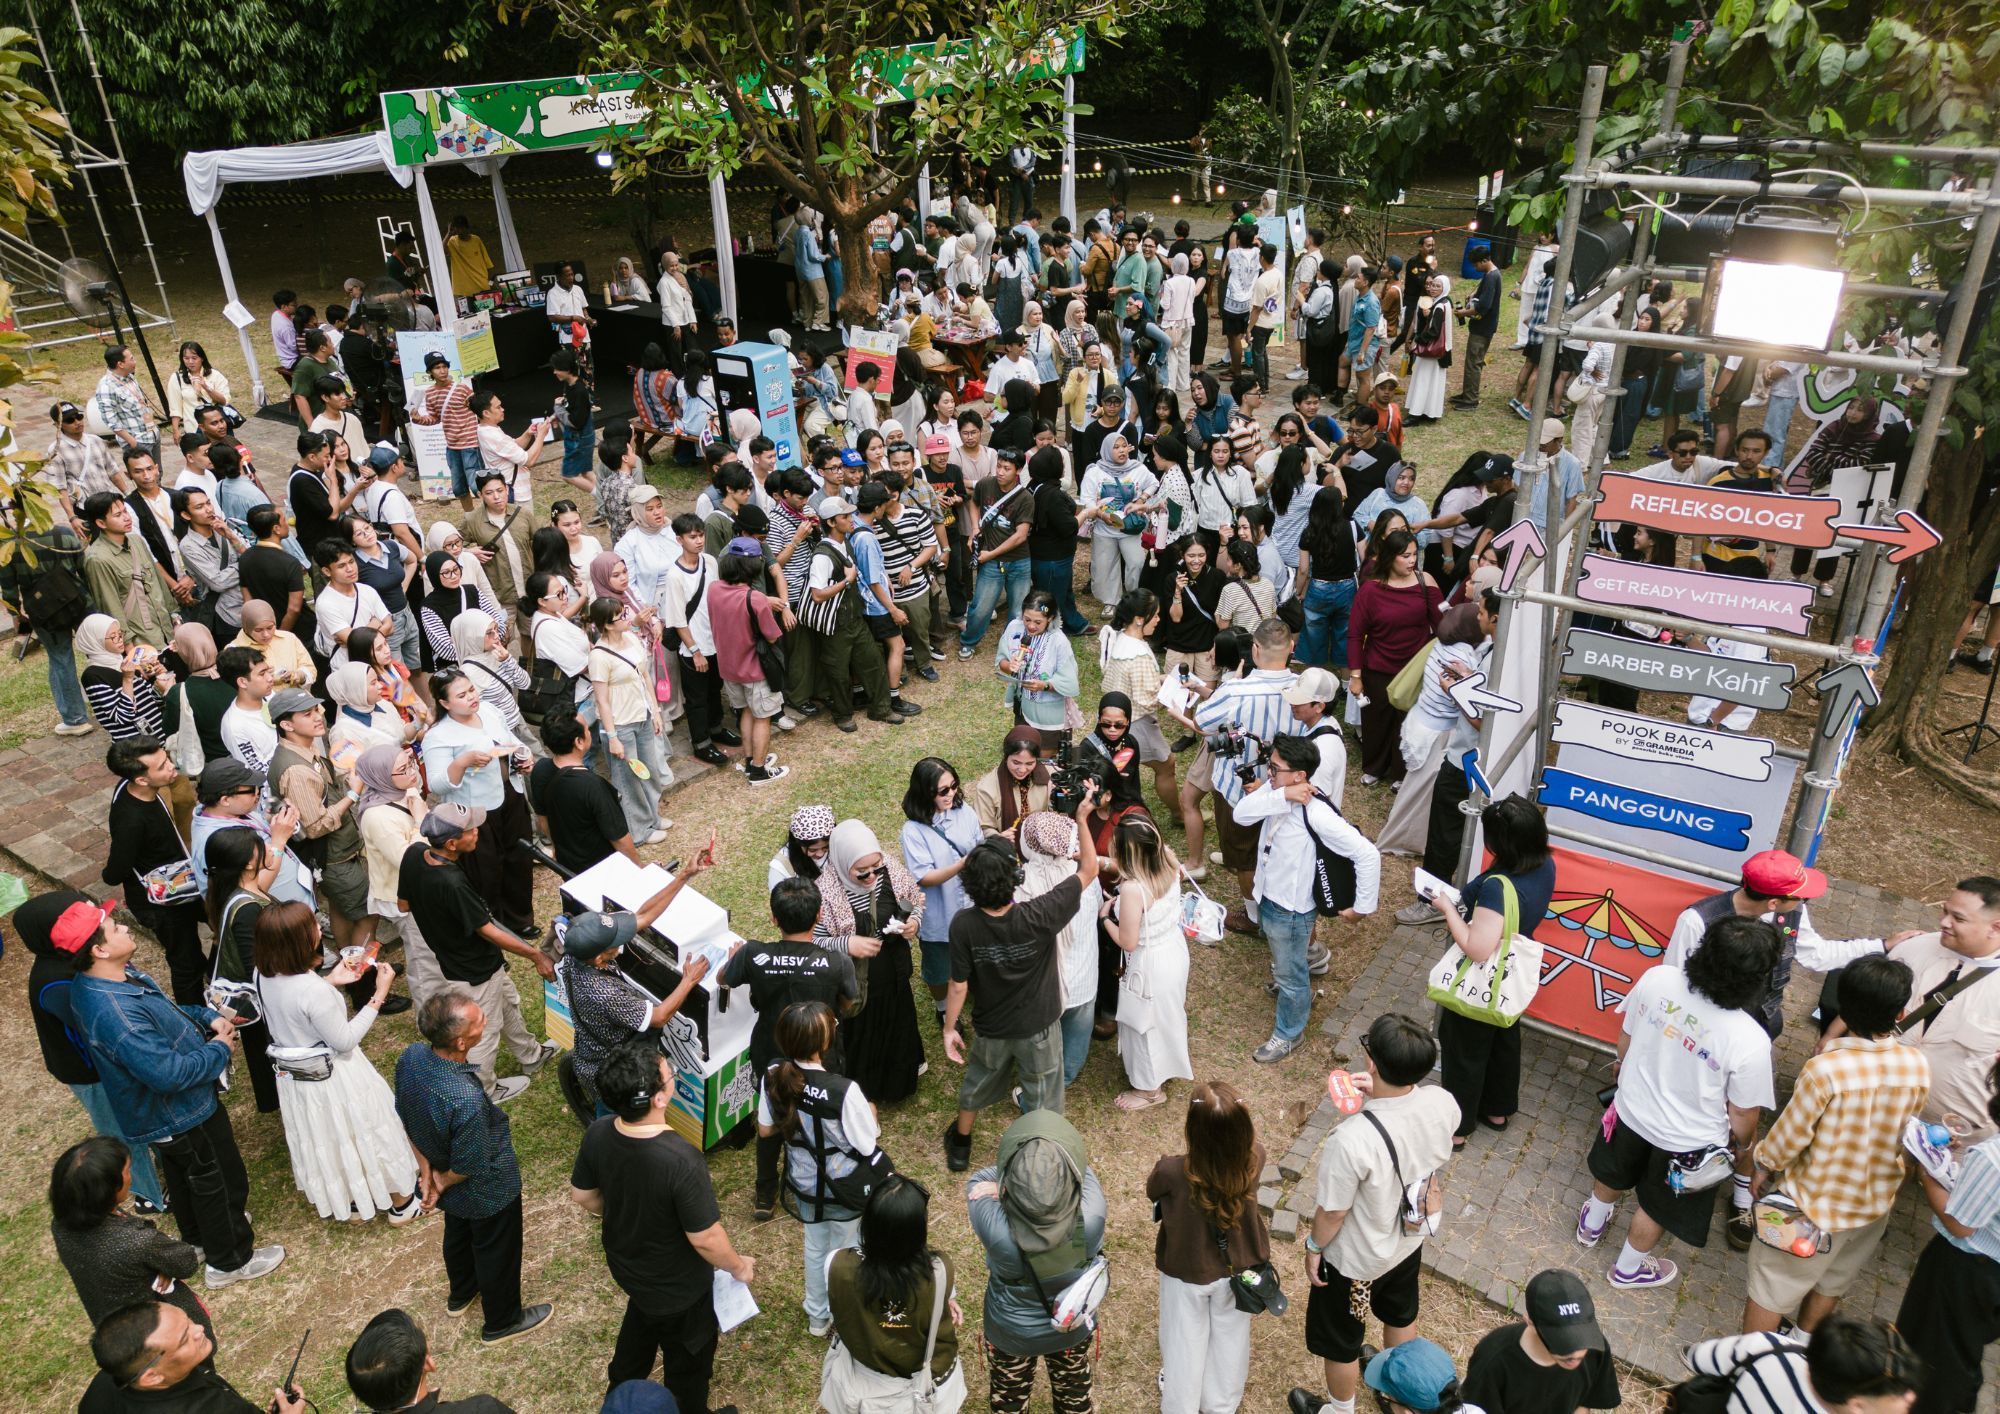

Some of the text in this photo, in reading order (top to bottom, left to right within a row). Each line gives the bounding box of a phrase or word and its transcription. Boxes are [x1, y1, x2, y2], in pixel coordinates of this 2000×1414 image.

[1630, 493, 1805, 530] REFLEKSOLOGI
[1593, 577, 1794, 615] GET READY WITH MAKA
[1584, 650, 1771, 696] BARBER BY Kahf
[1601, 719, 1714, 751] POJOK BACA
[1615, 737, 1630, 746] BY
[1646, 742, 1695, 757] GRAMEDIA
[1569, 786, 1716, 831] PANGGUNG
[1316, 858, 1334, 909] SATURDAYS
[1441, 972, 1510, 1008] RAPOT
[1558, 1303, 1581, 1316] NYC
